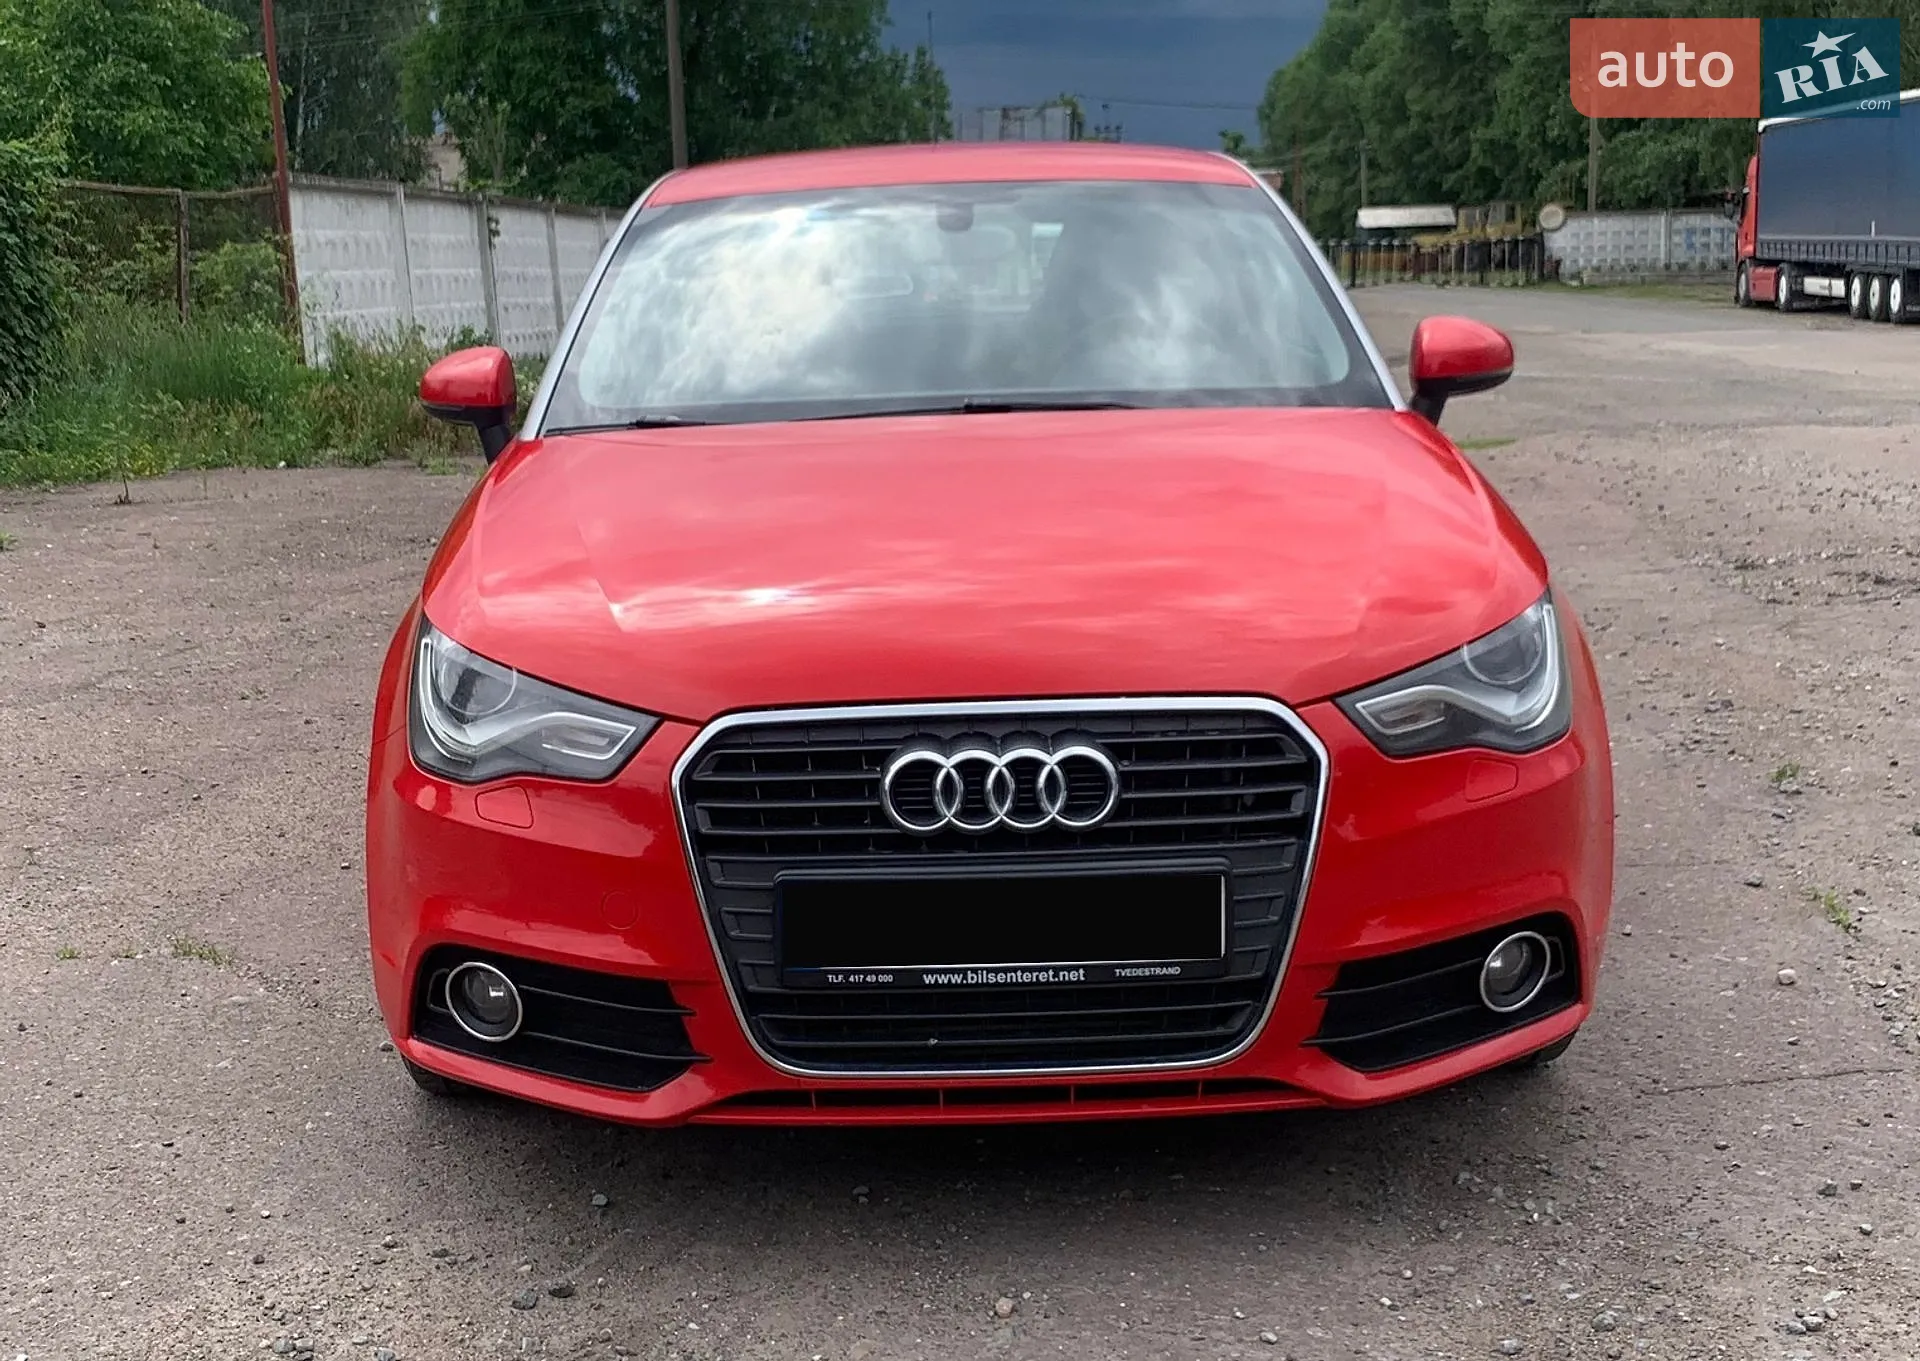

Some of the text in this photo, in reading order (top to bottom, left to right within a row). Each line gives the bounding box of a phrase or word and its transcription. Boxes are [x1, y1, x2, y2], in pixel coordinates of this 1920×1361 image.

[922, 968, 1086, 985] www.bilsenteret.net
[1114, 966, 1182, 977] TVEDESTRAND
[826, 974, 846, 983] TLF.
[848, 974, 864, 983] 417
[878, 974, 894, 983] 000
